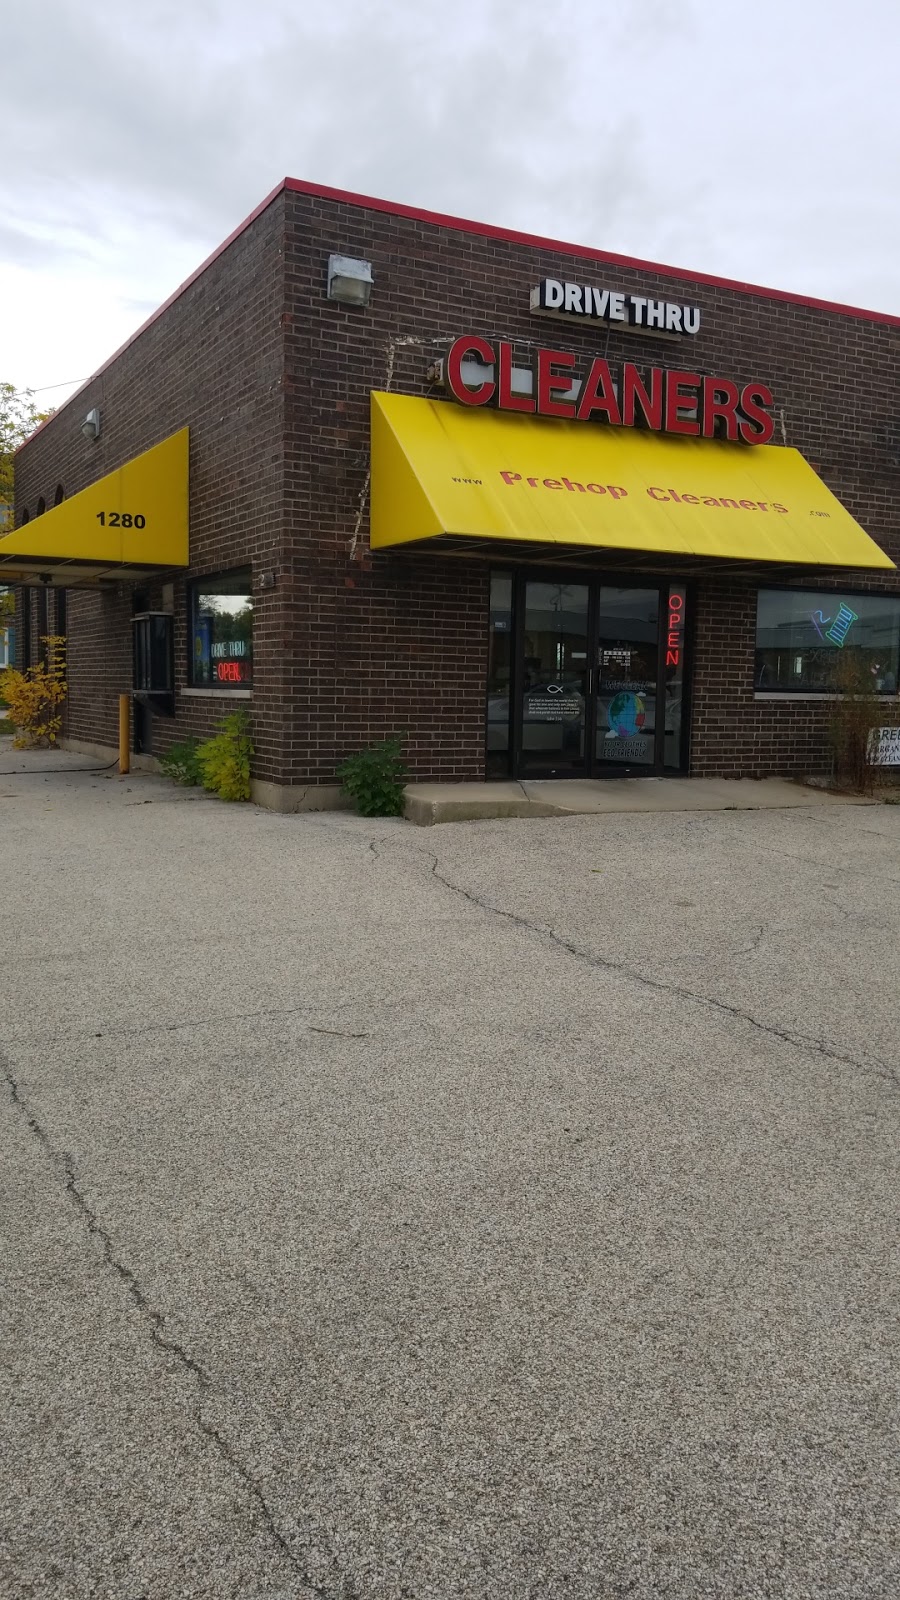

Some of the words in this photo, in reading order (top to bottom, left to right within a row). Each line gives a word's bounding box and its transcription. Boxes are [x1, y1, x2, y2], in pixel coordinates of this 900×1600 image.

[544, 278, 625, 321] DRIVE
[631, 296, 701, 335] THRU
[447, 335, 775, 446] CLEANERS
[500, 470, 629, 500] Prehop
[646, 487, 789, 515] Cleaners
[96, 511, 146, 529] 1280
[228, 641, 245, 656] THRU
[666, 594, 683, 666] OPEN
[218, 663, 241, 681] OPEN
